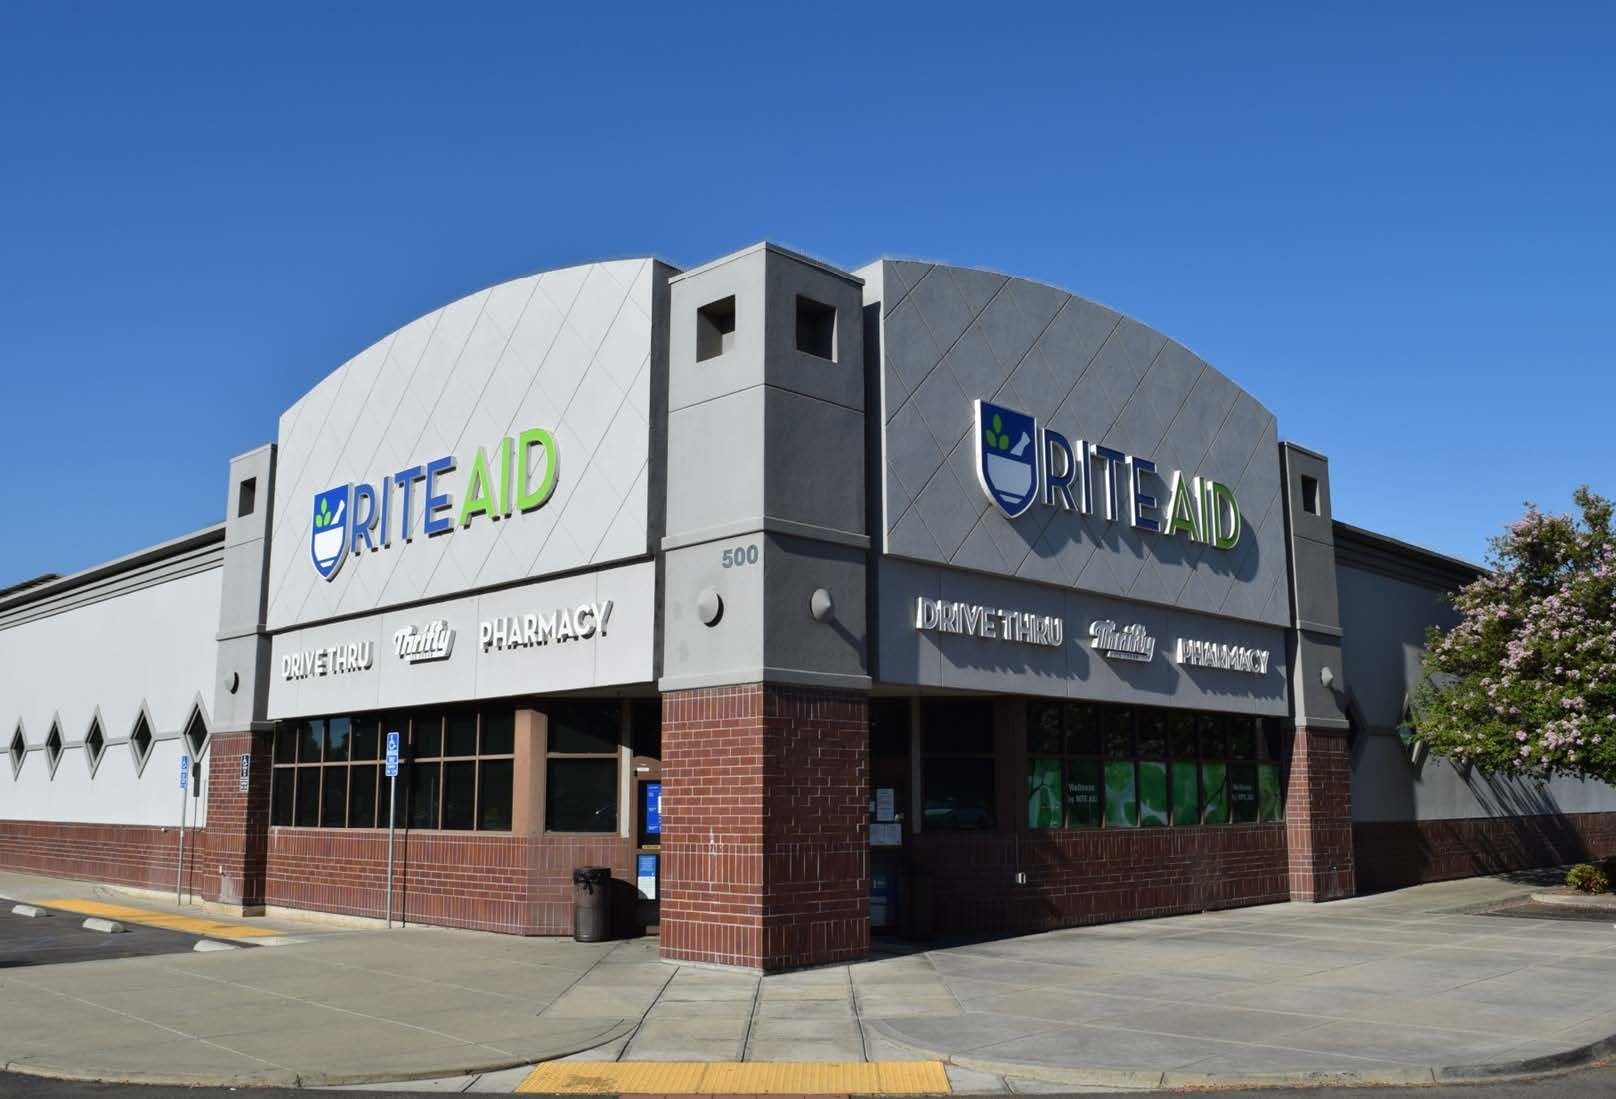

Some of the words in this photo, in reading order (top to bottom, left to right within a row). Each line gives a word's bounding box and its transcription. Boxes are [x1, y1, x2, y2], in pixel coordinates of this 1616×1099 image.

[351, 455, 457, 556] RITE
[458, 428, 560, 530] AID
[1042, 428, 1161, 532] RITE
[1165, 470, 1241, 549] AID
[722, 544, 758, 568] 500
[393, 618, 456, 661] Thrifty
[479, 600, 614, 652] PHARMACY
[916, 597, 996, 638] DRIVE
[998, 610, 1063, 647] THRU
[1089, 619, 1155, 660] Thrifty
[281, 648, 327, 680] DRIVE
[327, 641, 374, 675] THRU
[1177, 638, 1269, 673] PHARMACY
